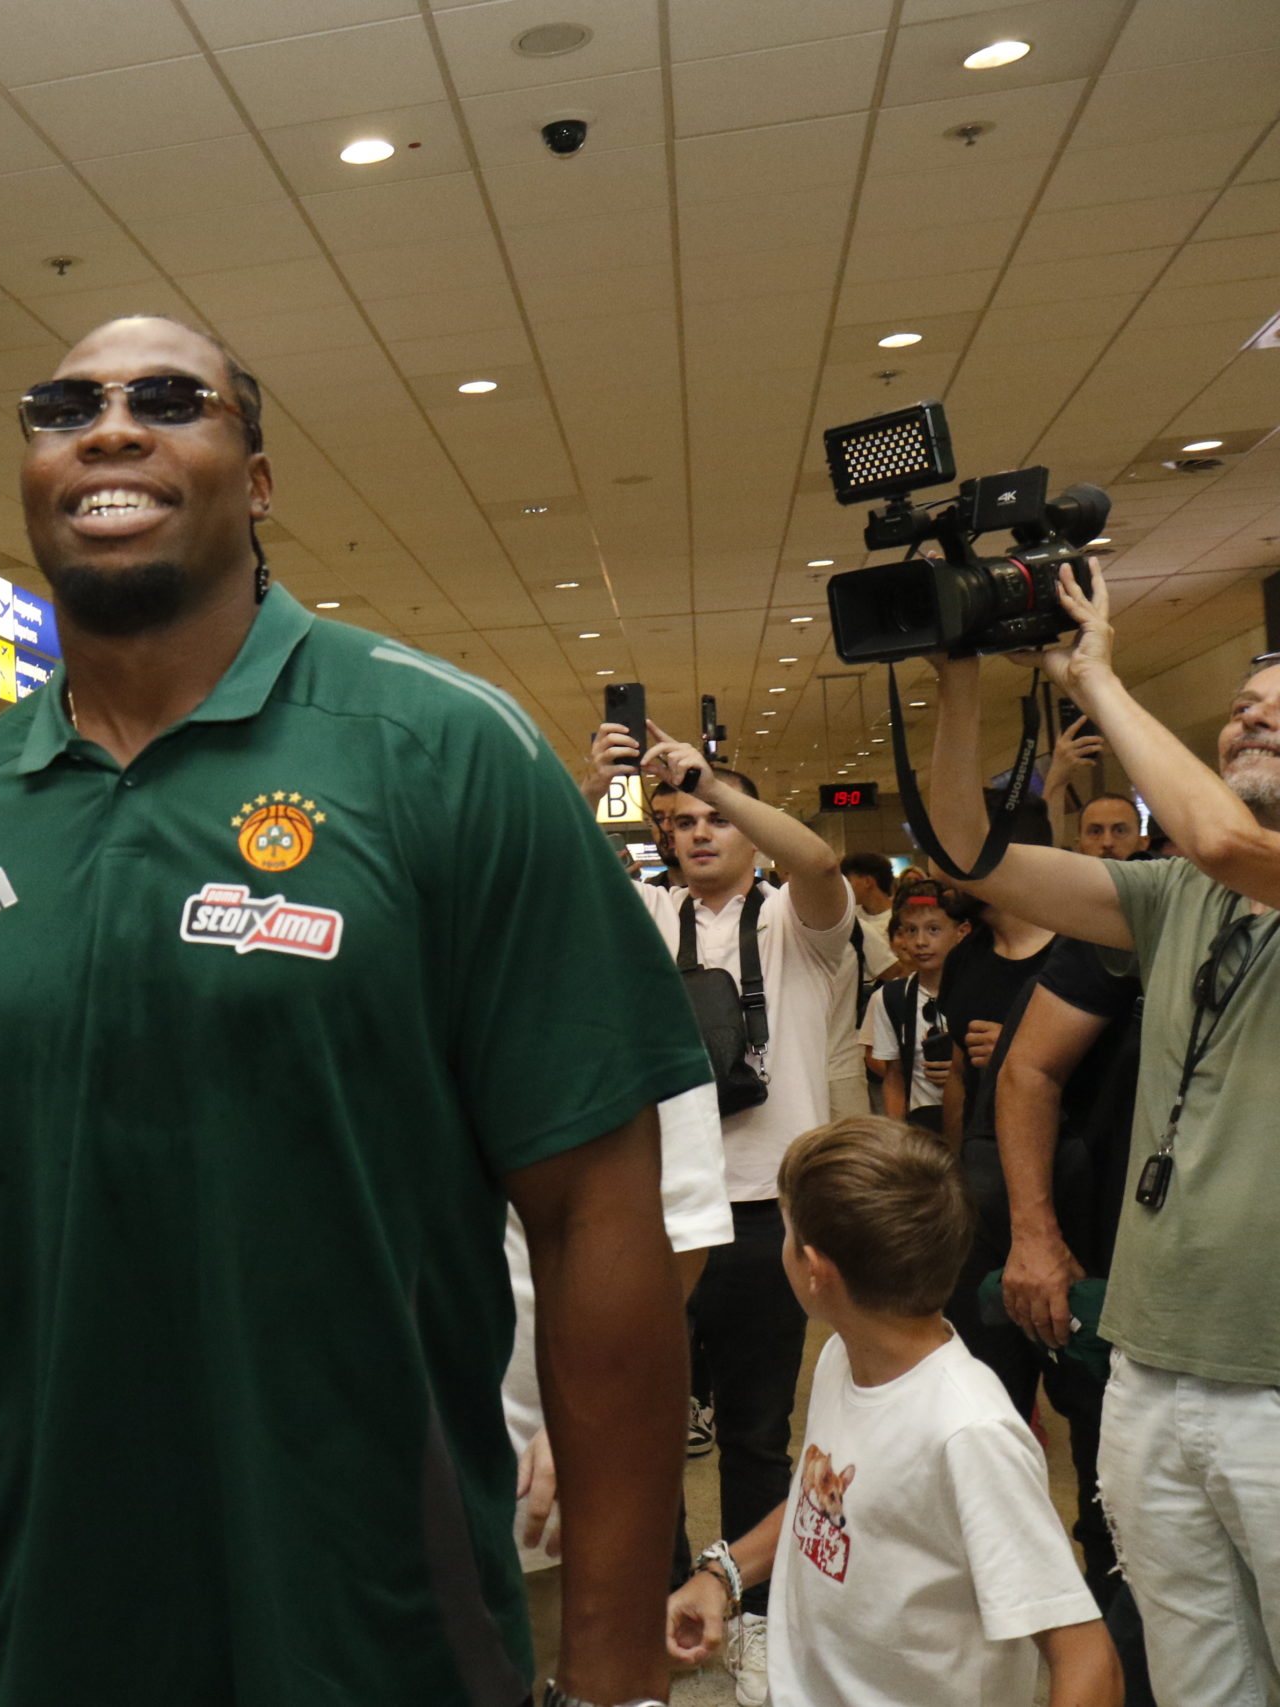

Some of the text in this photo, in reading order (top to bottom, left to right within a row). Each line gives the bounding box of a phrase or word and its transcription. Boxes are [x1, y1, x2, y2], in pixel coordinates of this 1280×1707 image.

[997, 490, 1017, 502] 4K
[1005, 738, 1036, 811] Panasonic
[607, 782, 628, 818] B
